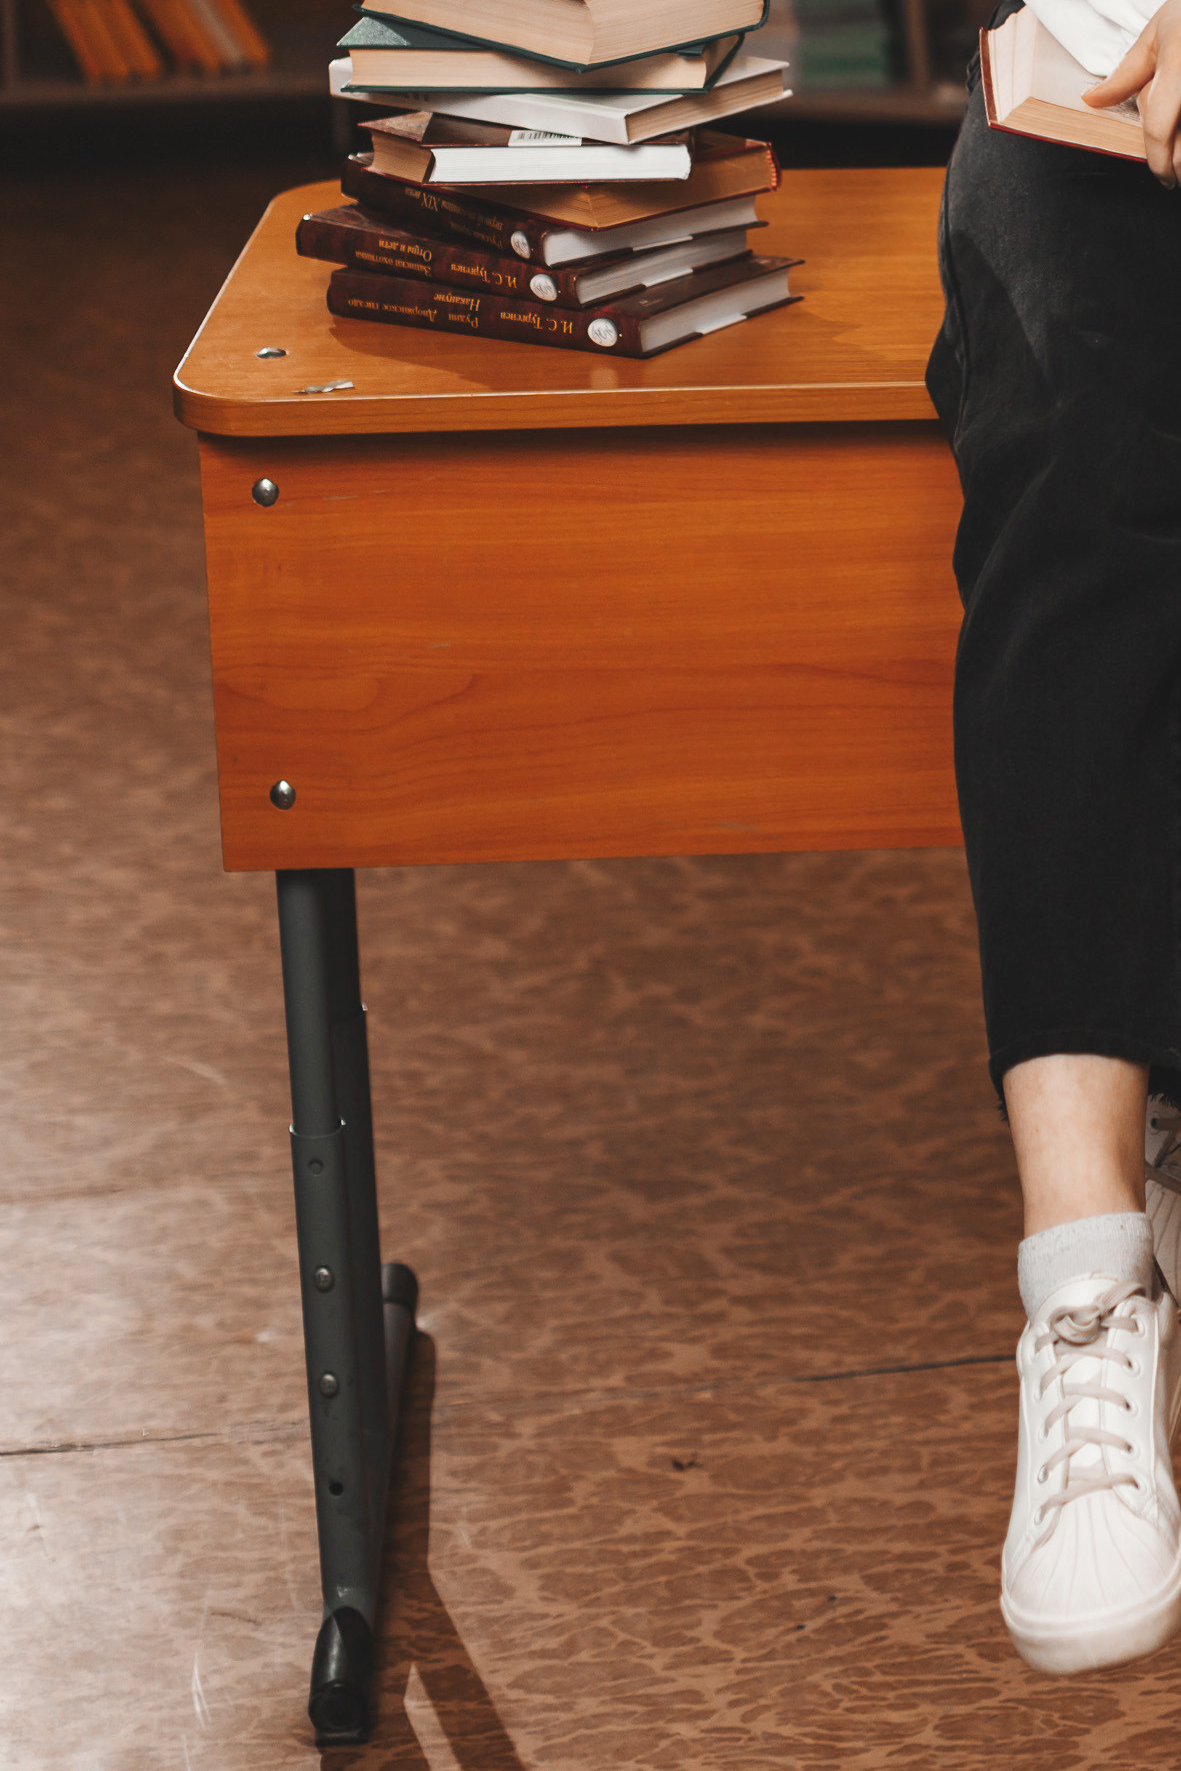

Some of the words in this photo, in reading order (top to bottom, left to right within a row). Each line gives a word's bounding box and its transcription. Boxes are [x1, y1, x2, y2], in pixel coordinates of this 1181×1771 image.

[421, 192, 441, 212] XIX
[378, 238, 399, 251] дети
[400, 244, 406, 252] и
[407, 244, 432, 262] Отцы
[395, 259, 432, 277] Записки
[450, 263, 491, 284] Тургенев
[491, 271, 503, 285] С.
[505, 274, 518, 289] И.
[433, 291, 480, 311] Накануне
[382, 302, 438, 323] Дворянское
[448, 313, 479, 329] Рудин
[500, 311, 543, 330] Тургенев
[546, 317, 558, 331] С.
[560, 319, 573, 334] И.
